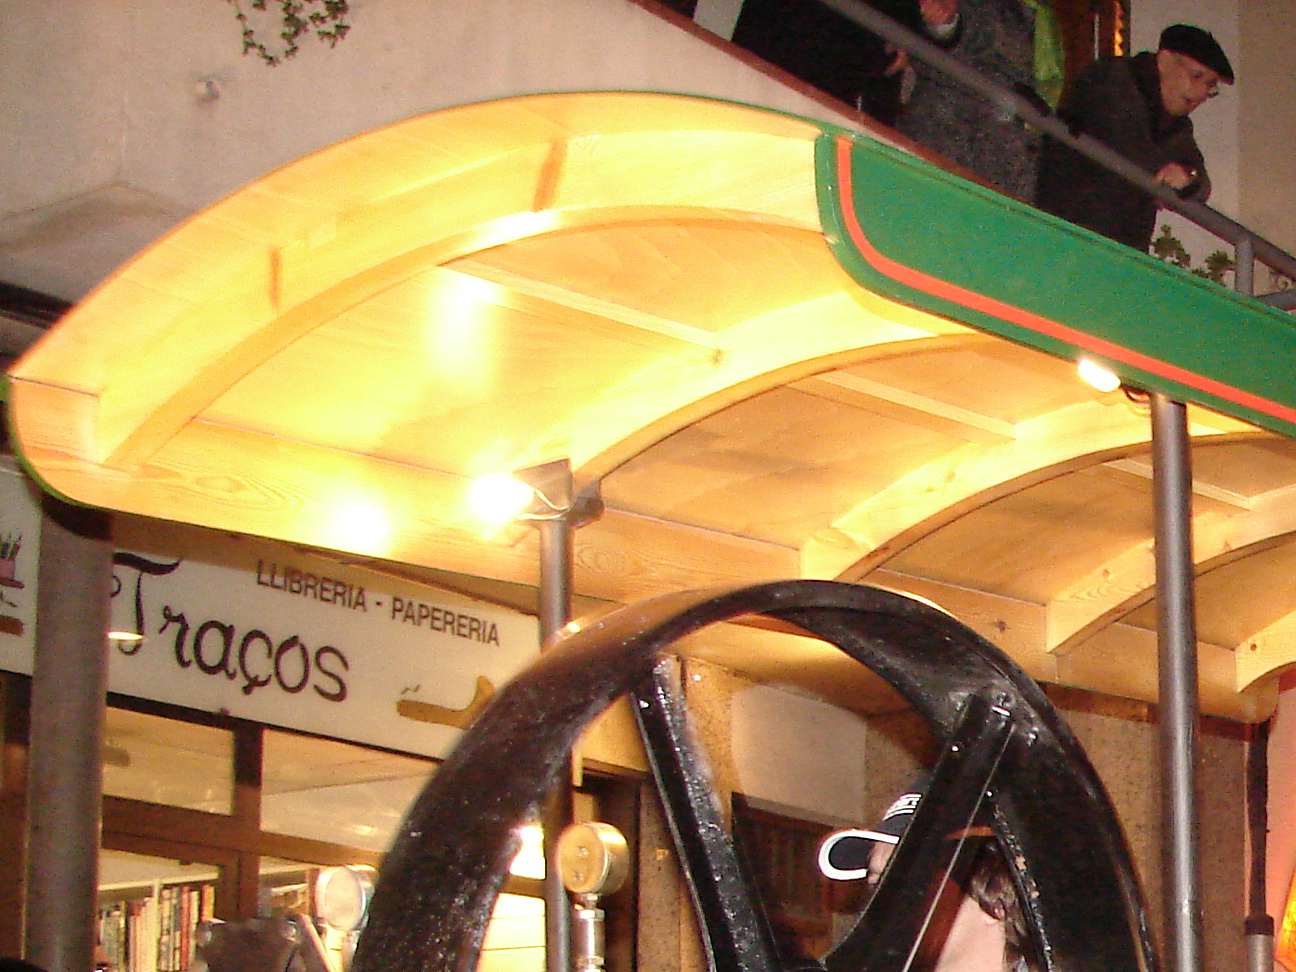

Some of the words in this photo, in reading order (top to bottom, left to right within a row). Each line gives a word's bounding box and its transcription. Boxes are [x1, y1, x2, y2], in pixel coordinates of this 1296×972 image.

[112, 551, 349, 703] Traços
[256, 558, 368, 613] LLIBRERIA
[391, 596, 500, 647] PAPERERIA
